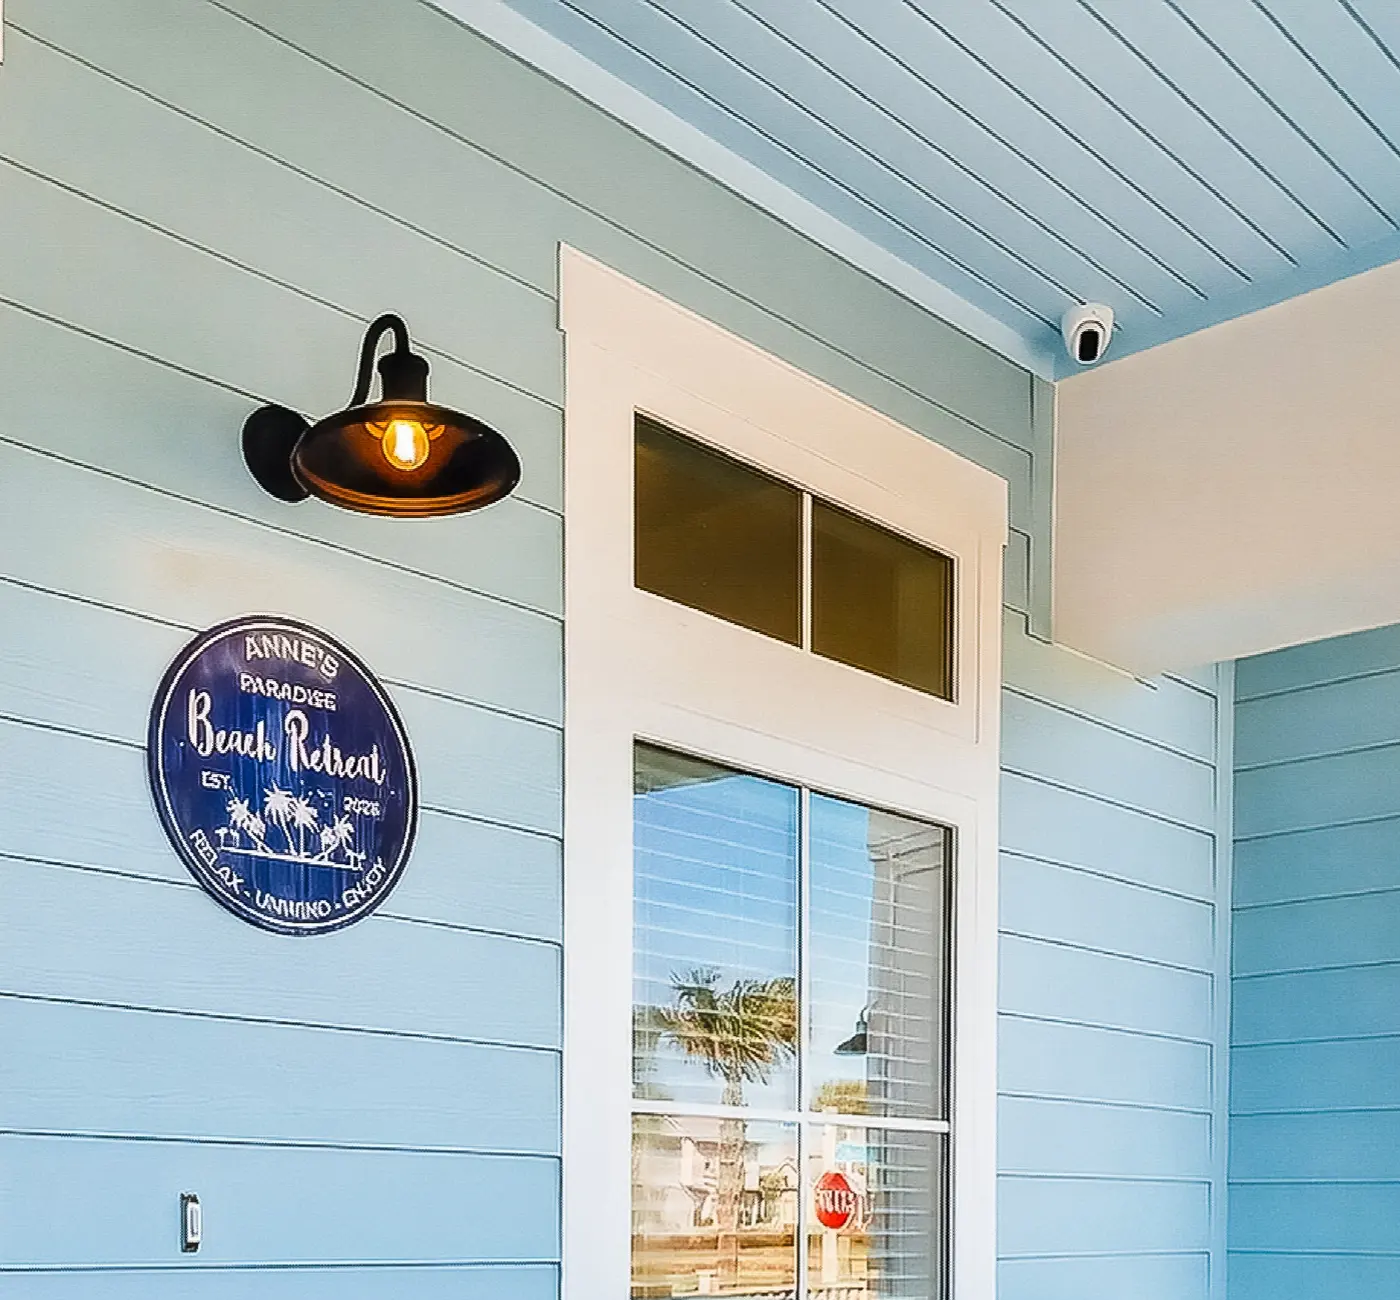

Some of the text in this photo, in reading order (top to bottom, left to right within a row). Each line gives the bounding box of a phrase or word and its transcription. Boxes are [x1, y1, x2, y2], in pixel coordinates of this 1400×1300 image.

[245, 635, 340, 678] ANNE'S
[240, 672, 337, 711] PARADISE
[188, 688, 388, 785] Beach Retreat
[189, 829, 246, 894] RELAX
[341, 855, 388, 908] ENJOY
